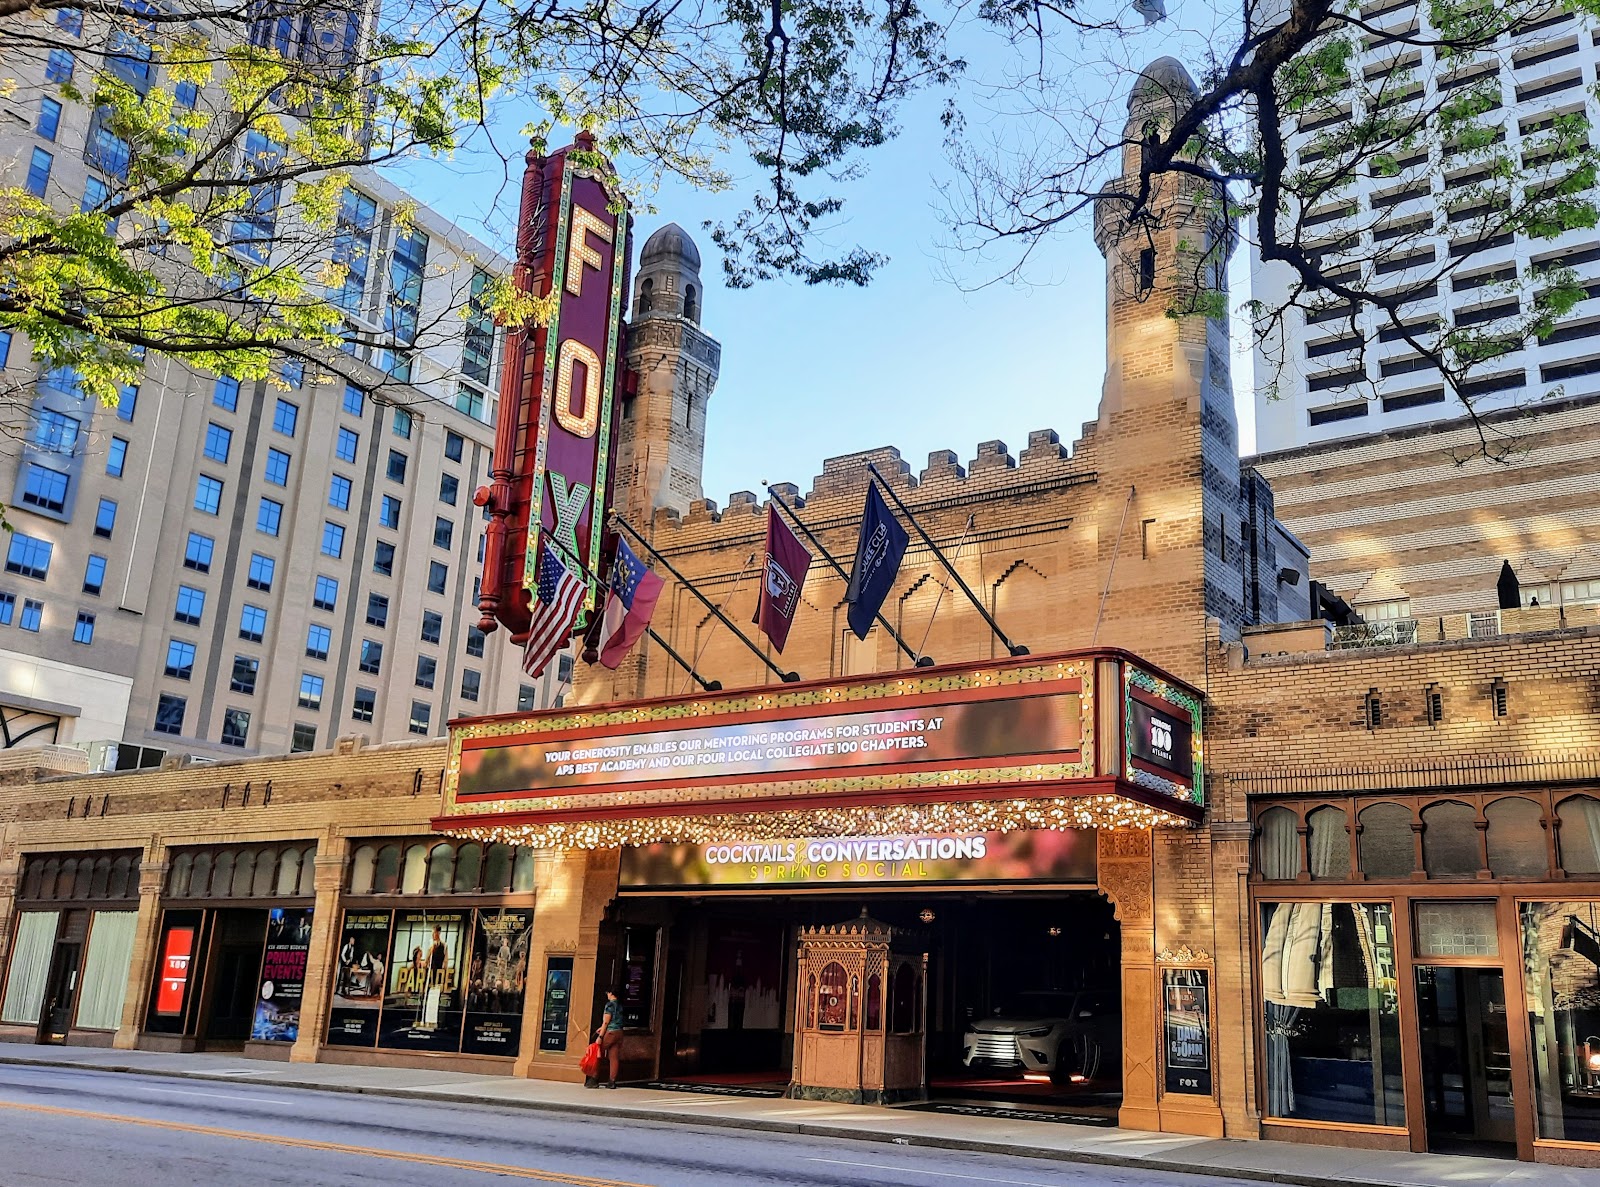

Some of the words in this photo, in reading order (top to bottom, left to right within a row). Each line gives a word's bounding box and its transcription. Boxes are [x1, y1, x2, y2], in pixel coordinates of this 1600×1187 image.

[546, 203, 612, 580] FOX
[872, 523, 886, 547] CLUB
[783, 585, 796, 613] THEATRE
[545, 751, 570, 763] YOUR
[572, 745, 633, 761] GENEROSITY
[633, 741, 678, 756] ENABLES
[679, 739, 701, 751] OUR
[704, 733, 768, 749] MENTORING
[770, 726, 834, 744] PROGRAMS
[836, 724, 860, 738] FOR
[862, 719, 925, 736] STUDENTS
[926, 717, 944, 731] AT
[1151, 726, 1172, 752] 100
[555, 763, 574, 776] APS
[575, 761, 599, 775] BEST
[599, 758, 648, 773] ACADEMY
[648, 756, 671, 769] AND
[672, 754, 696, 767] OUR
[697, 752, 727, 765] FOUR
[728, 748, 764, 761] LOCAL
[766, 742, 835, 760] COLLEGIATE
[837, 741, 857, 754] 100
[860, 735, 928, 752] CHAPTERS.
[1152, 747, 1172, 761] ATLANTA
[705, 844, 795, 864] COCKTAILS
[807, 836, 986, 863] CONVERSATIONS
[750, 864, 828, 879] SPRING
[842, 861, 928, 878] SOCIAL
[266, 951, 307, 965] PRIVATE
[263, 965, 305, 980] EVENTS
[1176, 1025, 1203, 1041] DAVE
[1171, 1041, 1178, 1053] &
[1177, 1041, 1203, 1057] JOHN
[1179, 1079, 1199, 1088] FOX
